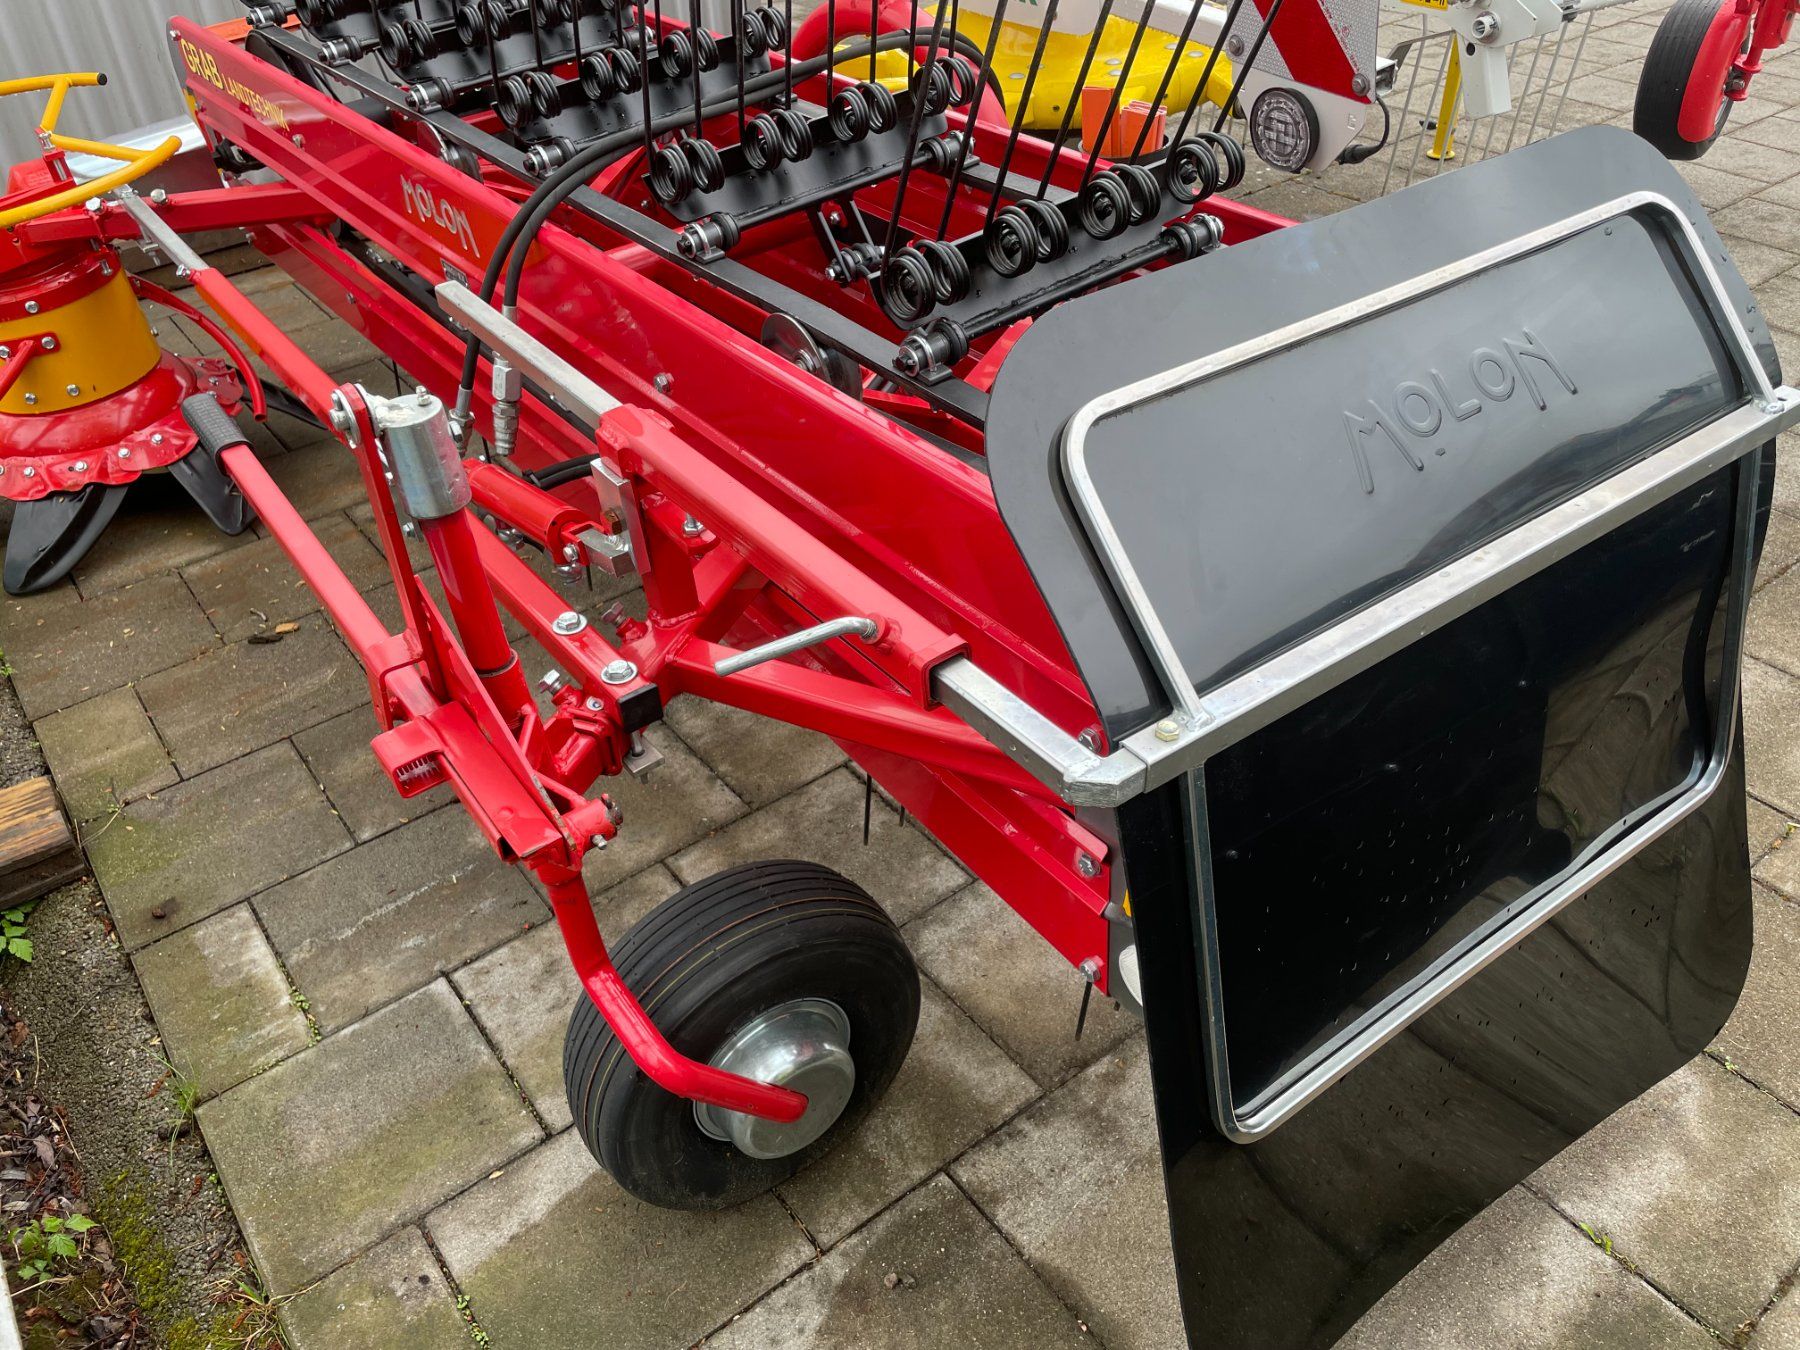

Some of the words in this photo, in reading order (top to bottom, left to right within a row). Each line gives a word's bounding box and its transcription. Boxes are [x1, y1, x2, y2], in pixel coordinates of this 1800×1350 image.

[180, 38, 224, 90] GRAB
[221, 72, 290, 132] LANDTECHNIK
[400, 174, 481, 258] MOLON
[1342, 327, 1578, 494] MOLON
